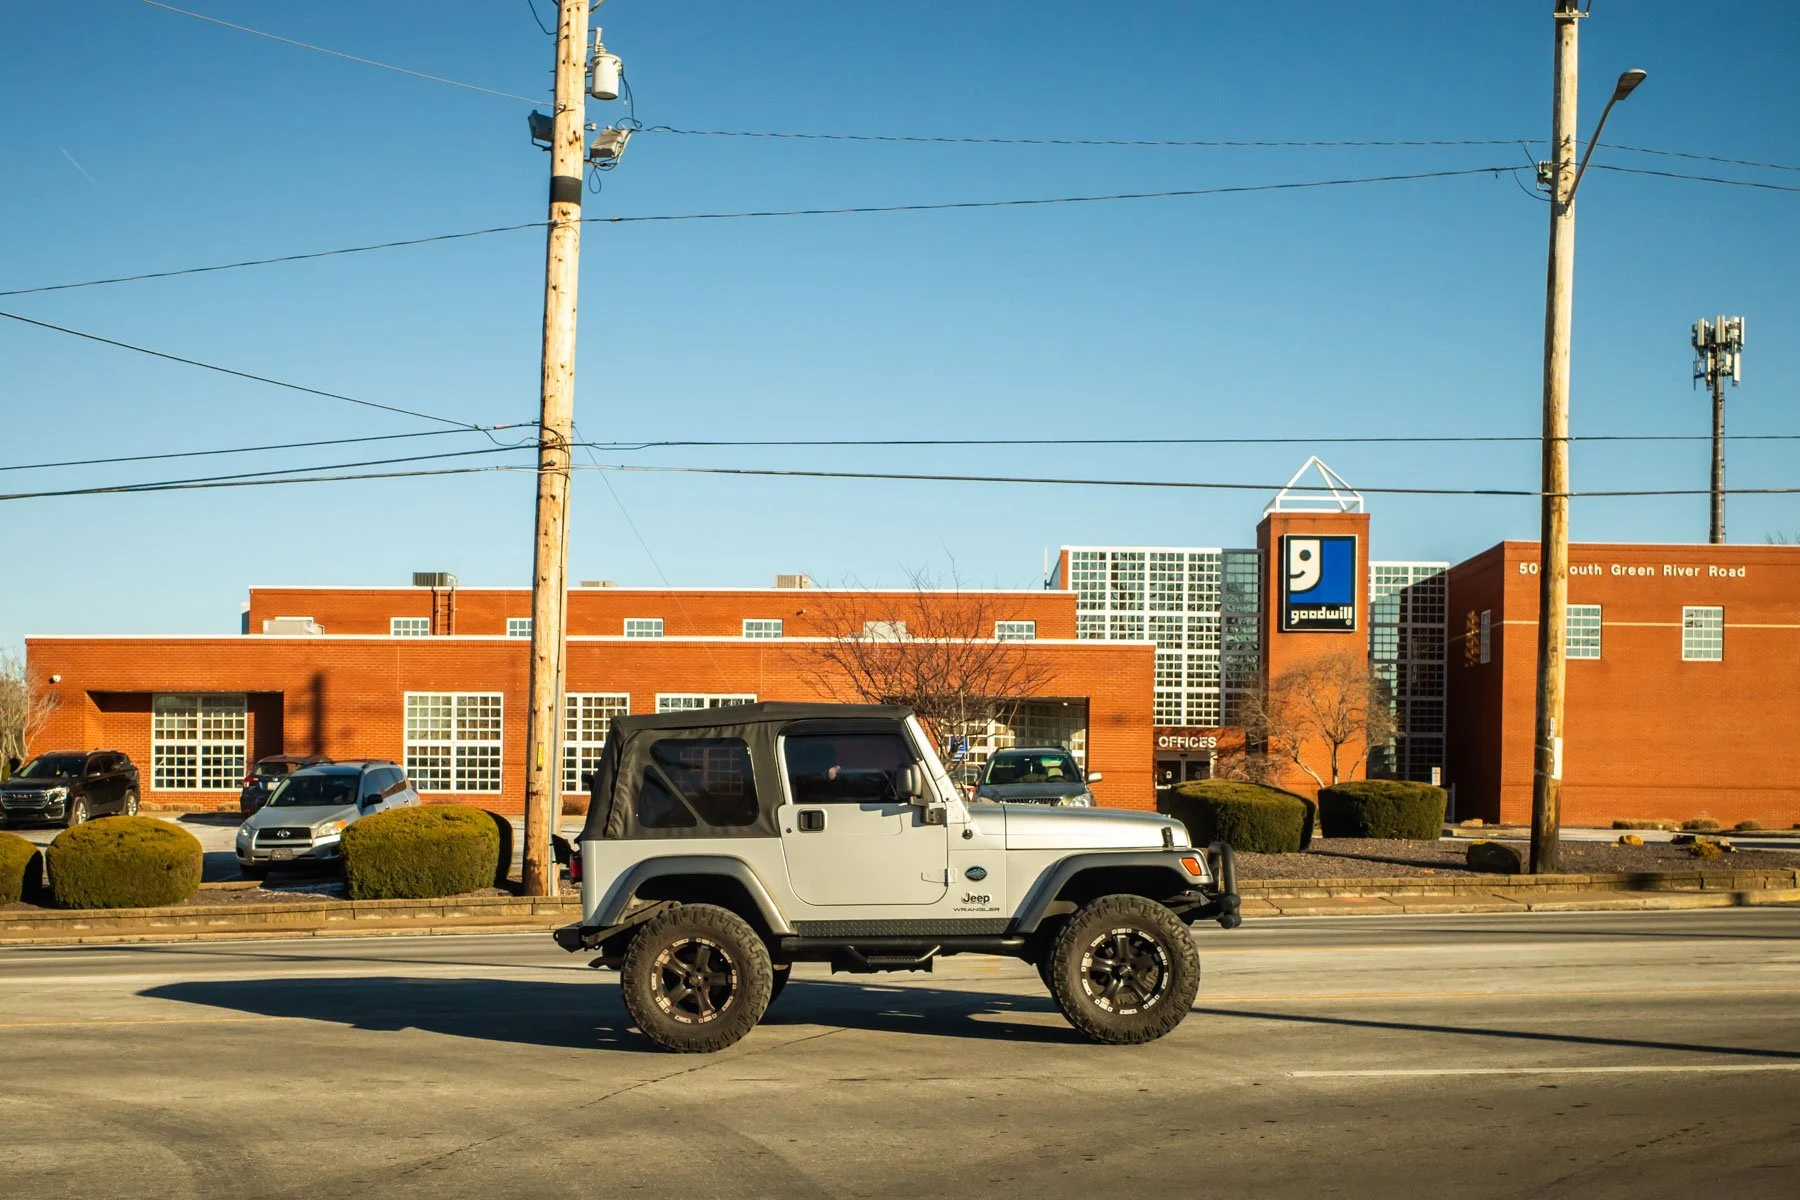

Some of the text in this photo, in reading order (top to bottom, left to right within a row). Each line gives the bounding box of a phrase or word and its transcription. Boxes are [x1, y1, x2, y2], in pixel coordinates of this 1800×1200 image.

[1519, 562, 1746, 577] 50 outh Green River Road
[1290, 606, 1353, 625] goodwill
[1158, 736, 1217, 748] OFFICES
[962, 892, 991, 904] Jeep
